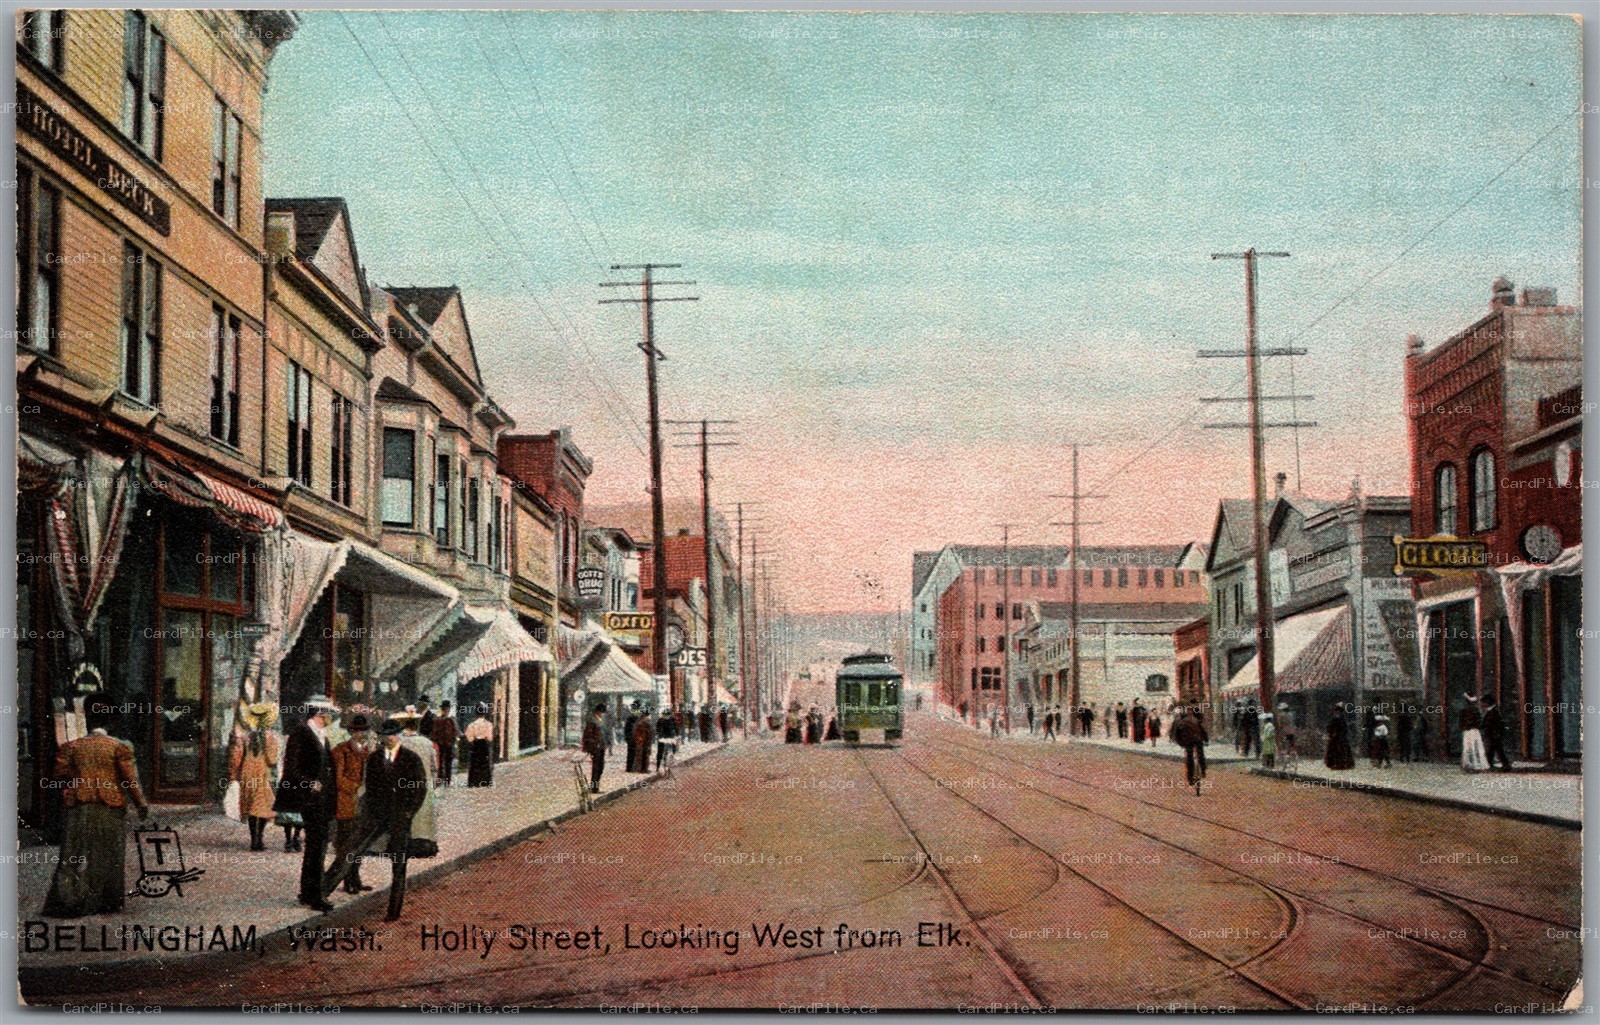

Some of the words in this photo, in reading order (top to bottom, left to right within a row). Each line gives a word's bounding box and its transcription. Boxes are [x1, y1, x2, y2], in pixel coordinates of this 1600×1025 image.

[32, 104, 97, 171] HOTEL
[1403, 544, 1486, 566] GLOBE
[578, 579, 603, 588] DRUG
